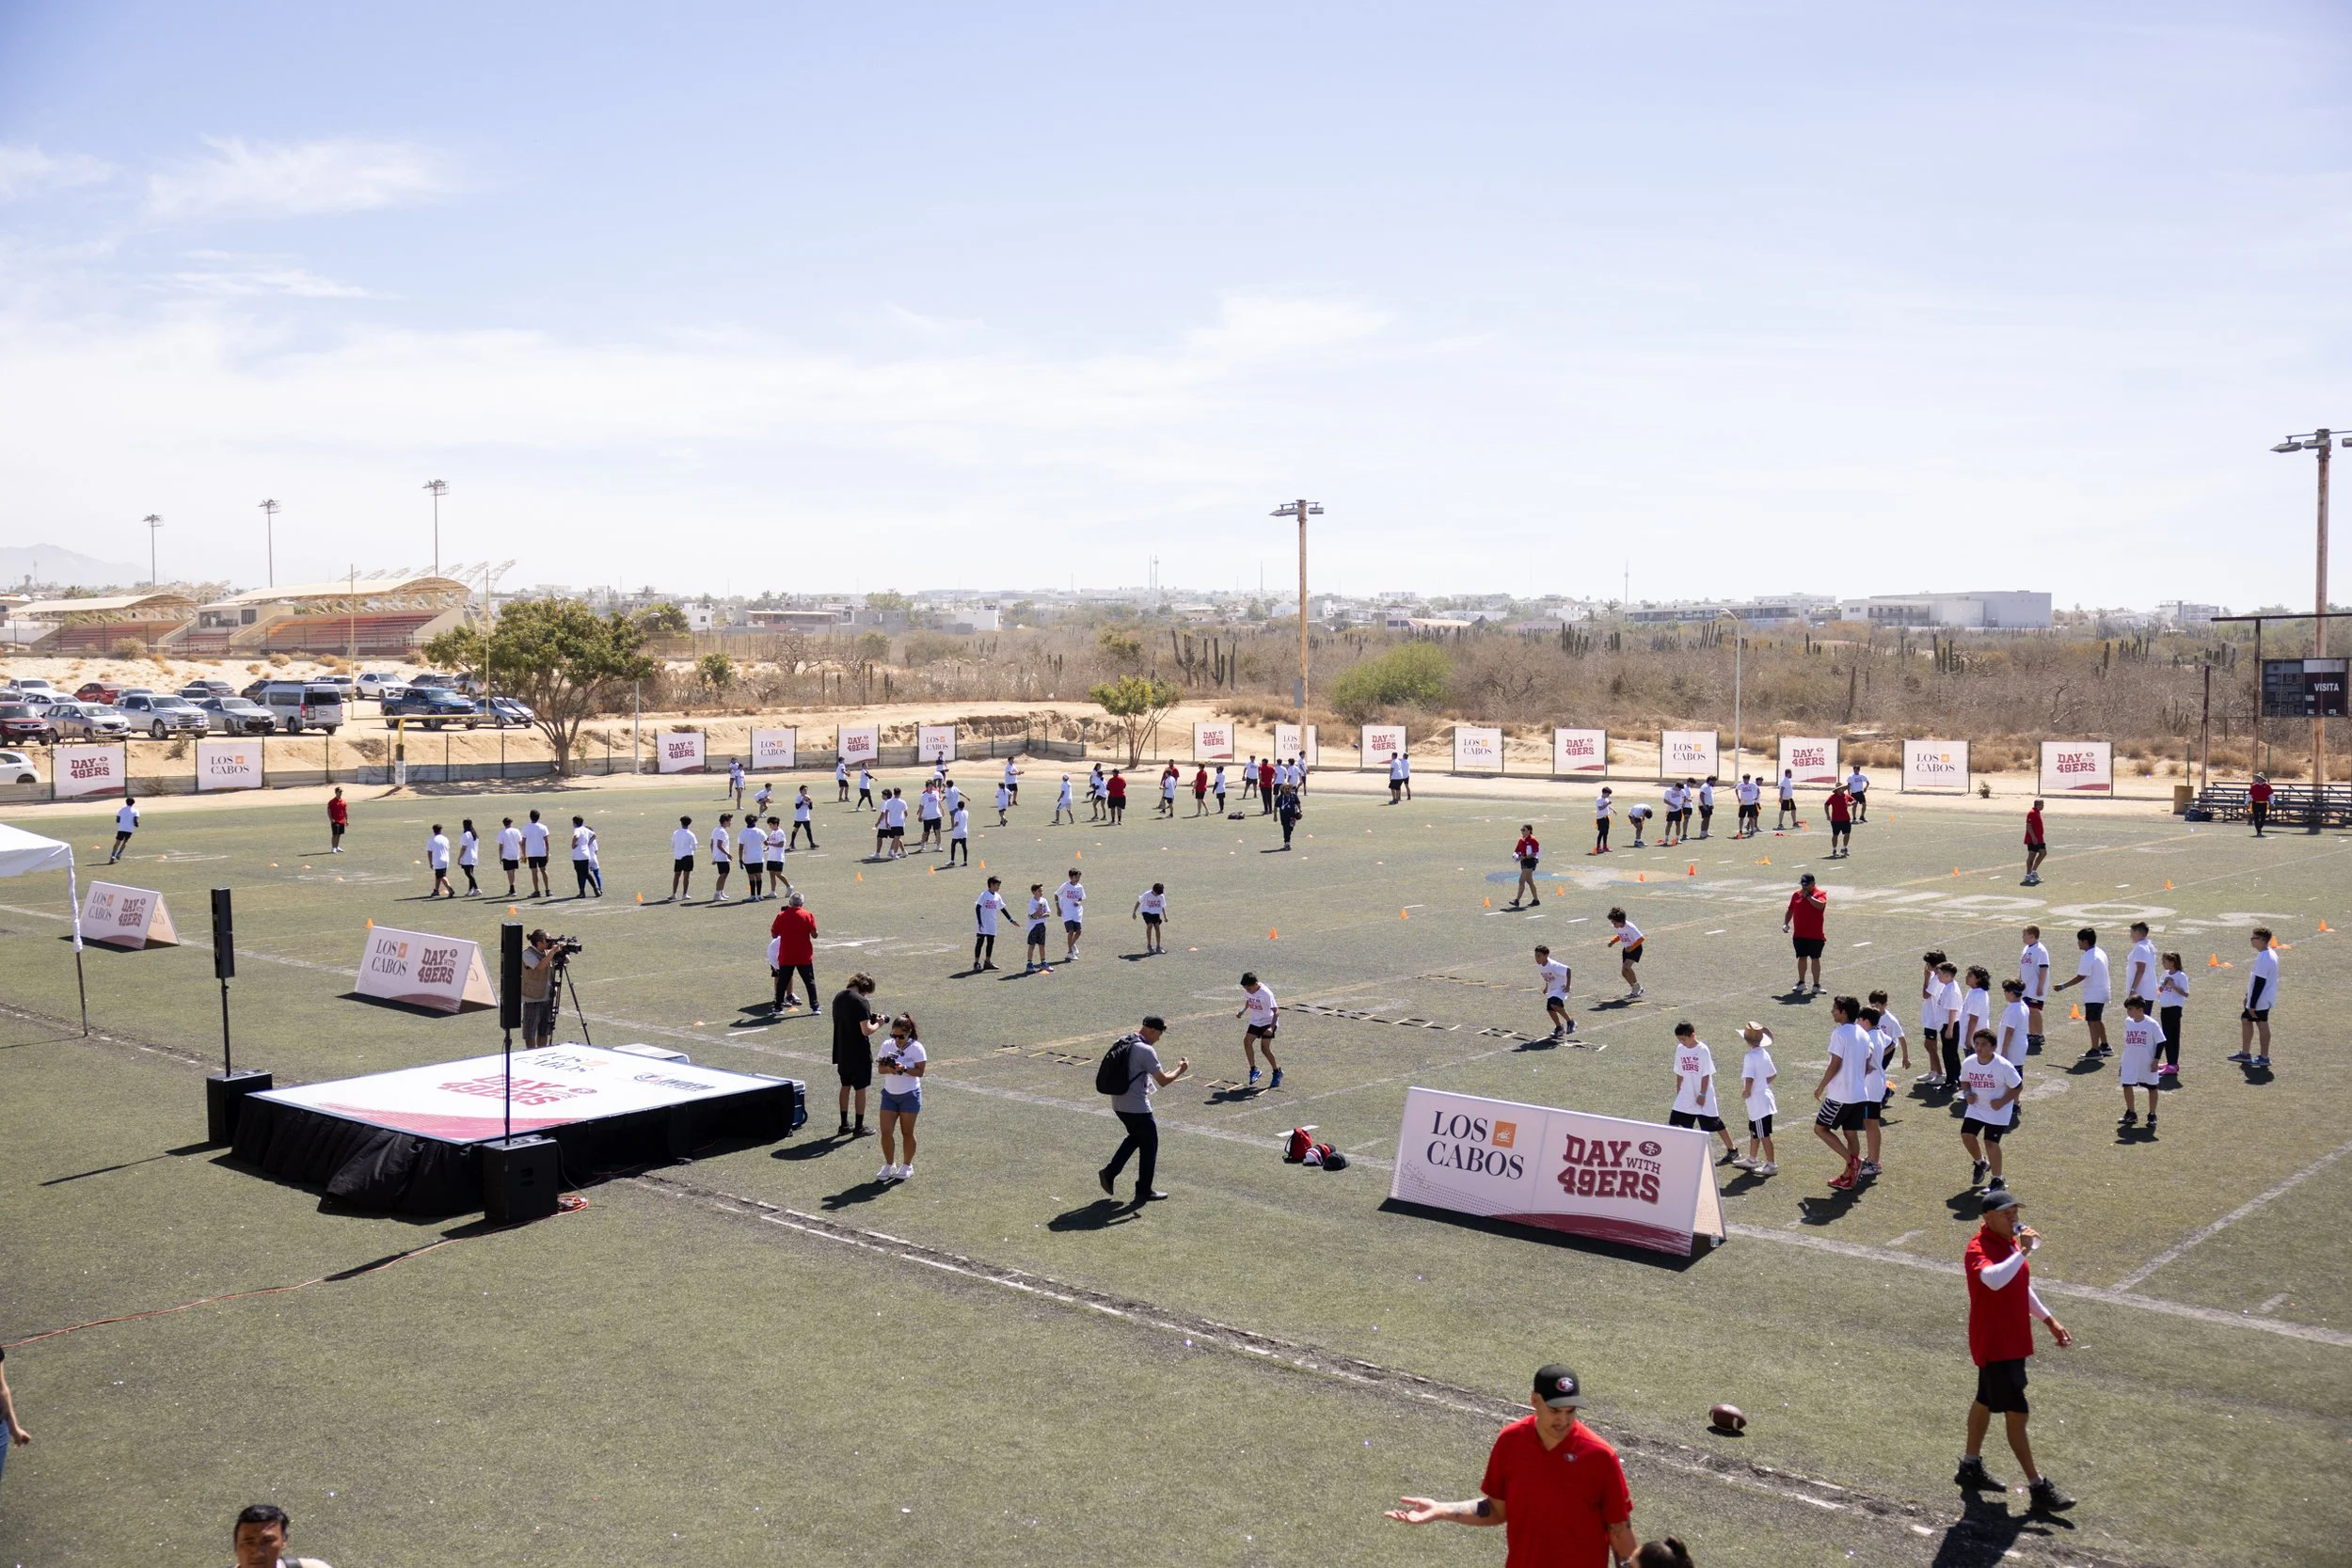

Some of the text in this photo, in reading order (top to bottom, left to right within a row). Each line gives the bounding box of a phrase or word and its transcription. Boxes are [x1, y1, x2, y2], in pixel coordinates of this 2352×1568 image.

[2313, 682, 2340, 692] VISITA
[1203, 731, 1217, 739] DAY
[1372, 734, 1389, 743] DAY
[760, 740, 775, 749] LOS
[848, 736, 863, 745] DAY
[1464, 738, 1480, 747] LOS
[1566, 738, 1584, 748] DAY
[668, 741, 686, 752] DAY
[847, 743, 869, 752] 49ERS
[1371, 741, 1396, 751] 49ERS
[1463, 747, 1492, 755] CABOS
[1565, 746, 1595, 755] 49ERS
[1674, 743, 1692, 752] LOS
[668, 749, 695, 759] 49ERS
[760, 748, 787, 756] CABOS
[1673, 752, 1706, 761] CABOS
[1792, 748, 1814, 758] DAY
[1916, 752, 1939, 762] LOS
[71, 757, 96, 769] DAY
[211, 755, 233, 765] LOS
[1791, 757, 1825, 767] 49ERS
[2057, 752, 2083, 764] DAY
[211, 765, 249, 774] CABOS
[1916, 763, 1955, 772] CABOS
[2057, 762, 2096, 773] 49ERS
[71, 767, 110, 779] 49ERS
[92, 891, 108, 906] LOS
[121, 897, 139, 913] DAY
[88, 906, 113, 922] CABOS
[119, 912, 143, 927] 49ERS
[375, 939, 399, 957] LOS
[421, 947, 457, 969] DAY WITH
[372, 956, 408, 977] CABOS
[418, 966, 454, 986] 49ERS
[1968, 1072, 1985, 1081] DAY
[1431, 1110, 1488, 1143] LOS
[1562, 1132, 1661, 1176] DAY WITH
[1425, 1140, 1525, 1180] CABOS
[1556, 1164, 1661, 1206] 49ERS
